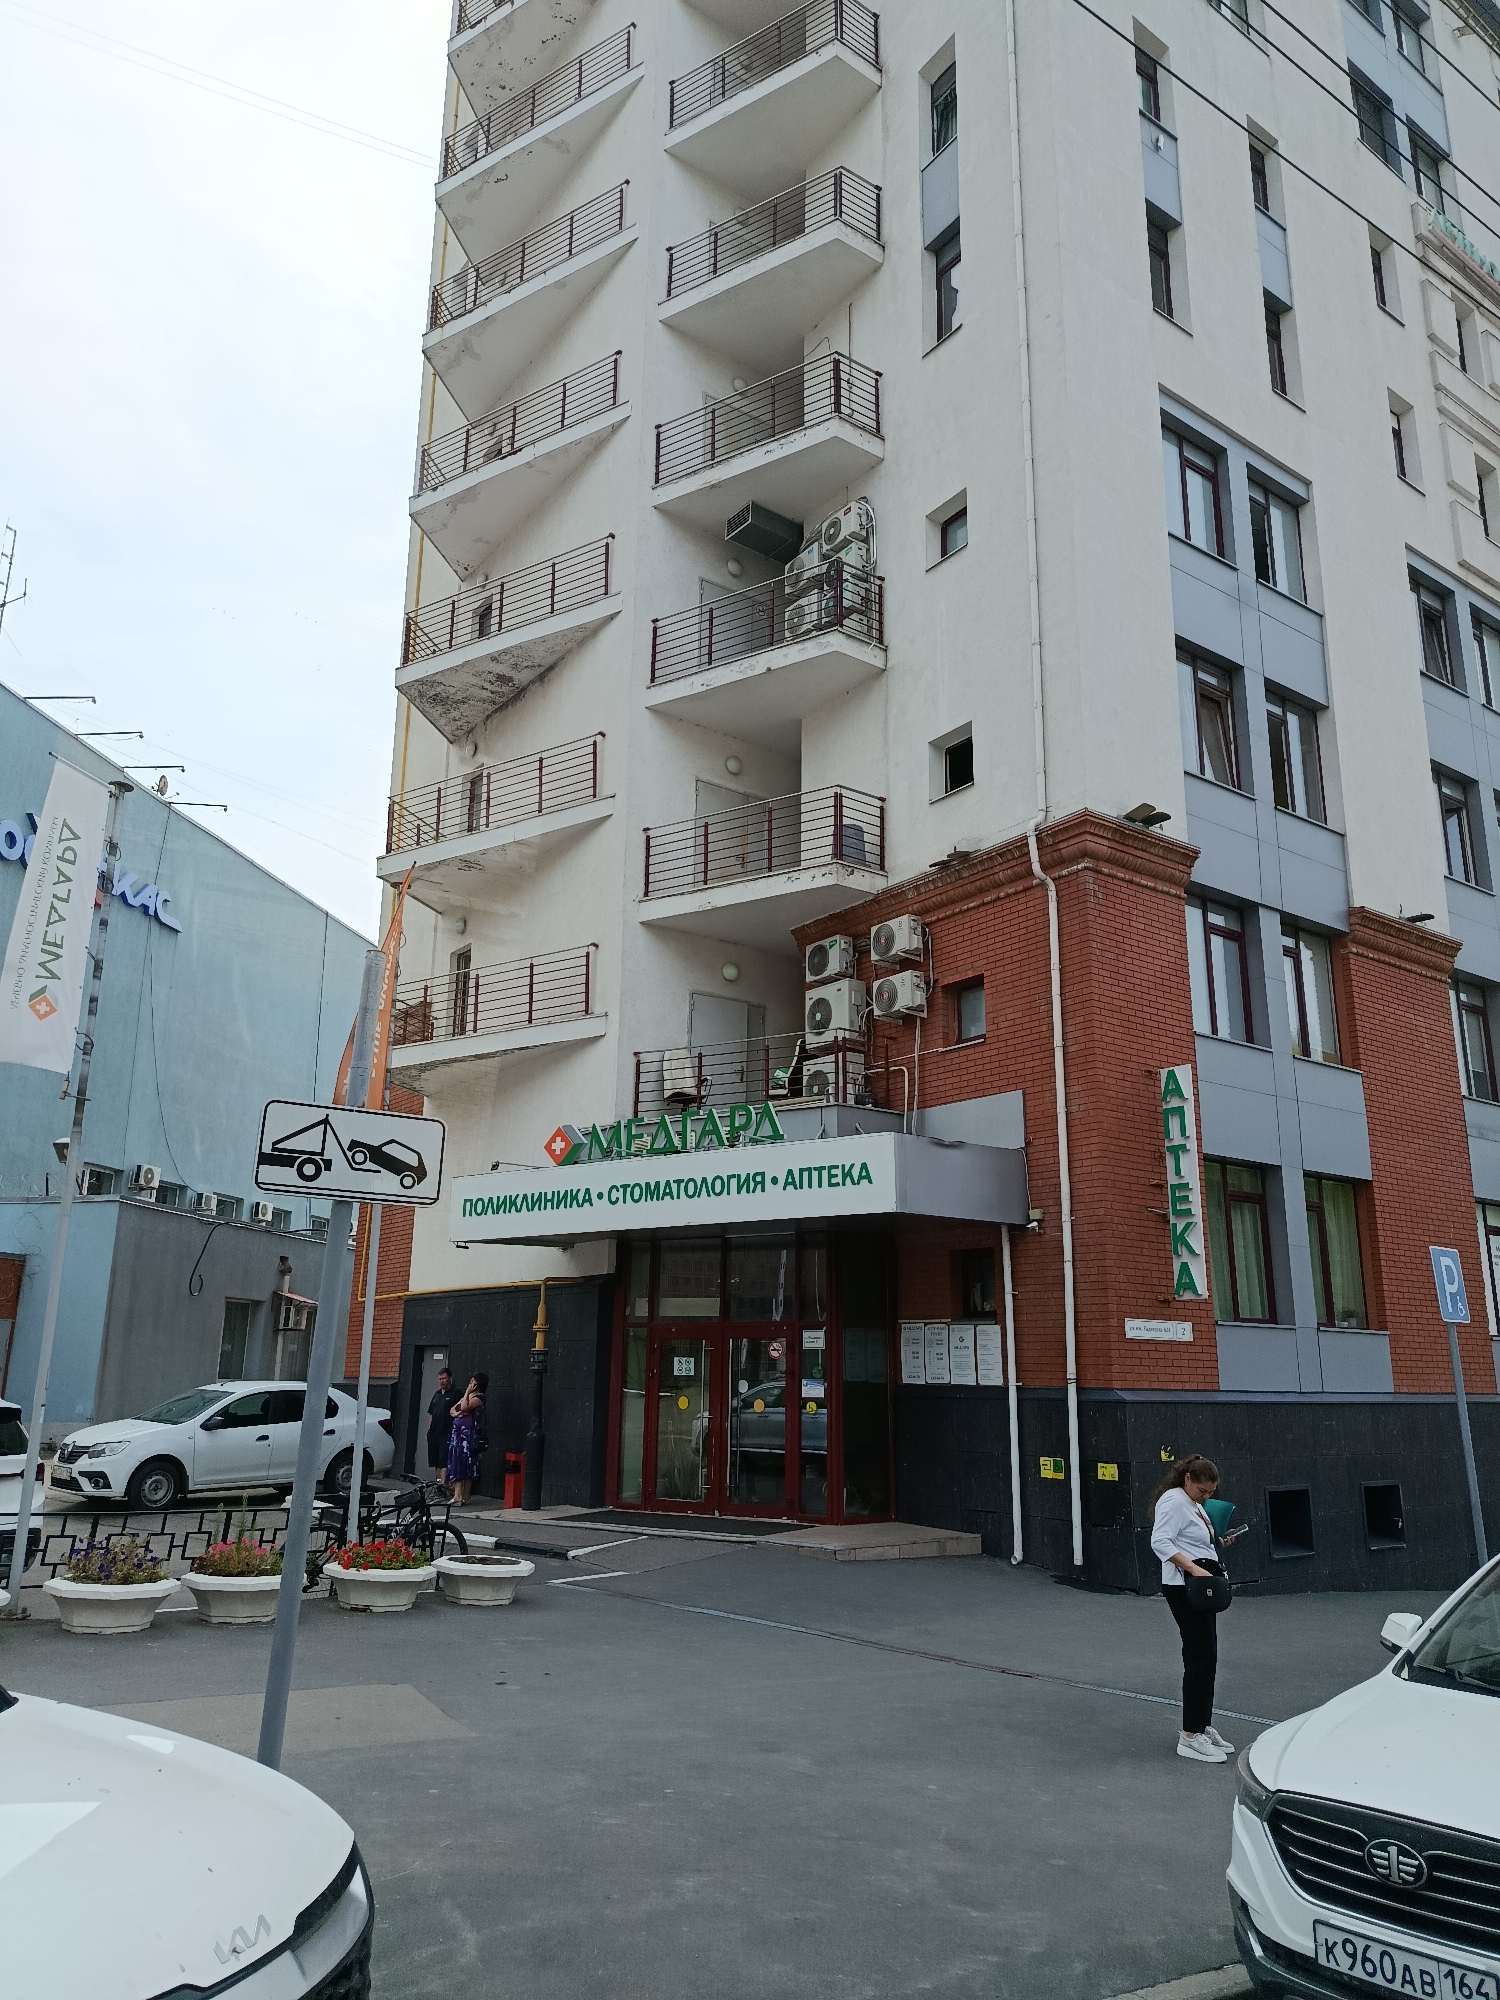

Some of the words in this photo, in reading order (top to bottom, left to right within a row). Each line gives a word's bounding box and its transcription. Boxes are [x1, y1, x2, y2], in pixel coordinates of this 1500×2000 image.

[588, 1100, 786, 1160] МЕДГАРД
[462, 1186, 593, 1217] ПОЛИКЛИНИКА
[607, 1171, 767, 1206] СТОМАТОЛОГИЯ
[782, 1161, 874, 1191] АПТЕКА
[1162, 1069, 1203, 1297] АПТЕКА
